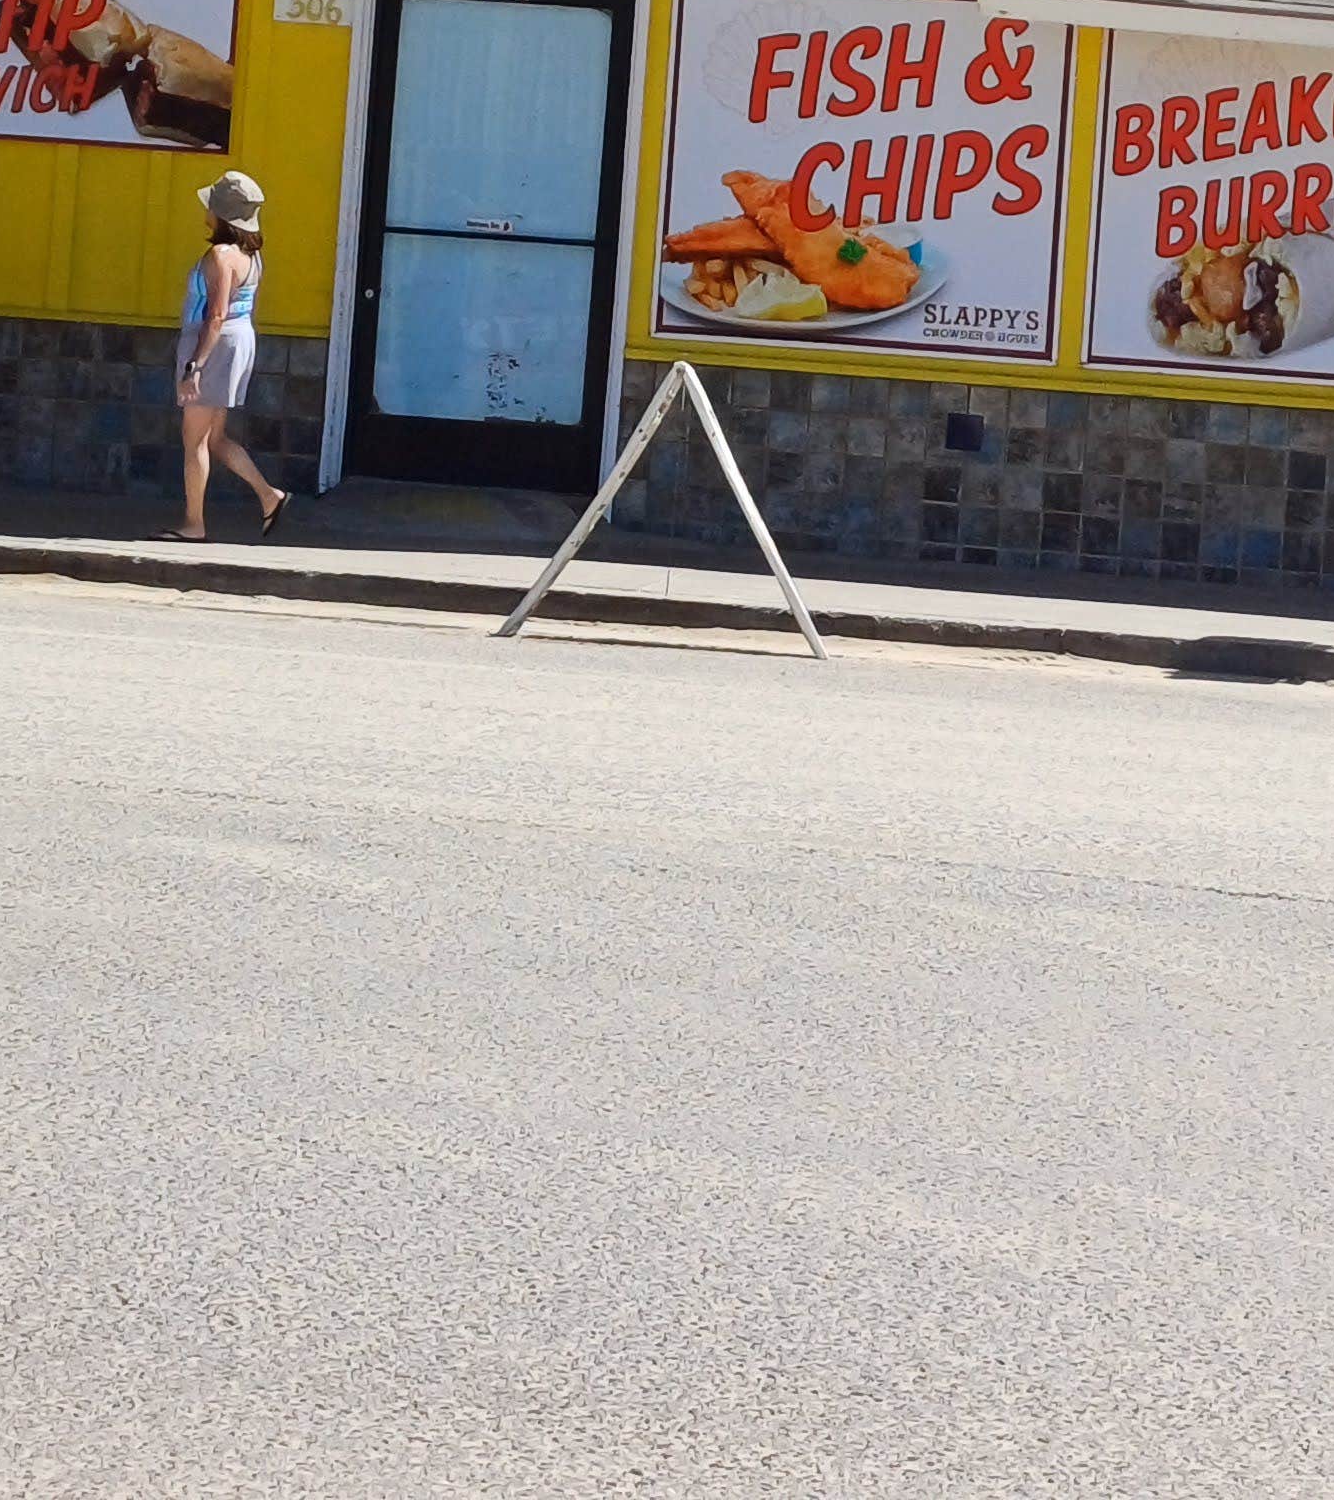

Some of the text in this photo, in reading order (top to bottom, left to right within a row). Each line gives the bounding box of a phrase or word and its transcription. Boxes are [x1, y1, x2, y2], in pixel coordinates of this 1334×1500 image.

[747, 16, 1035, 123] FISH &
[788, 124, 1050, 232] CHIPS
[923, 303, 1039, 331] SLAPPY'S
